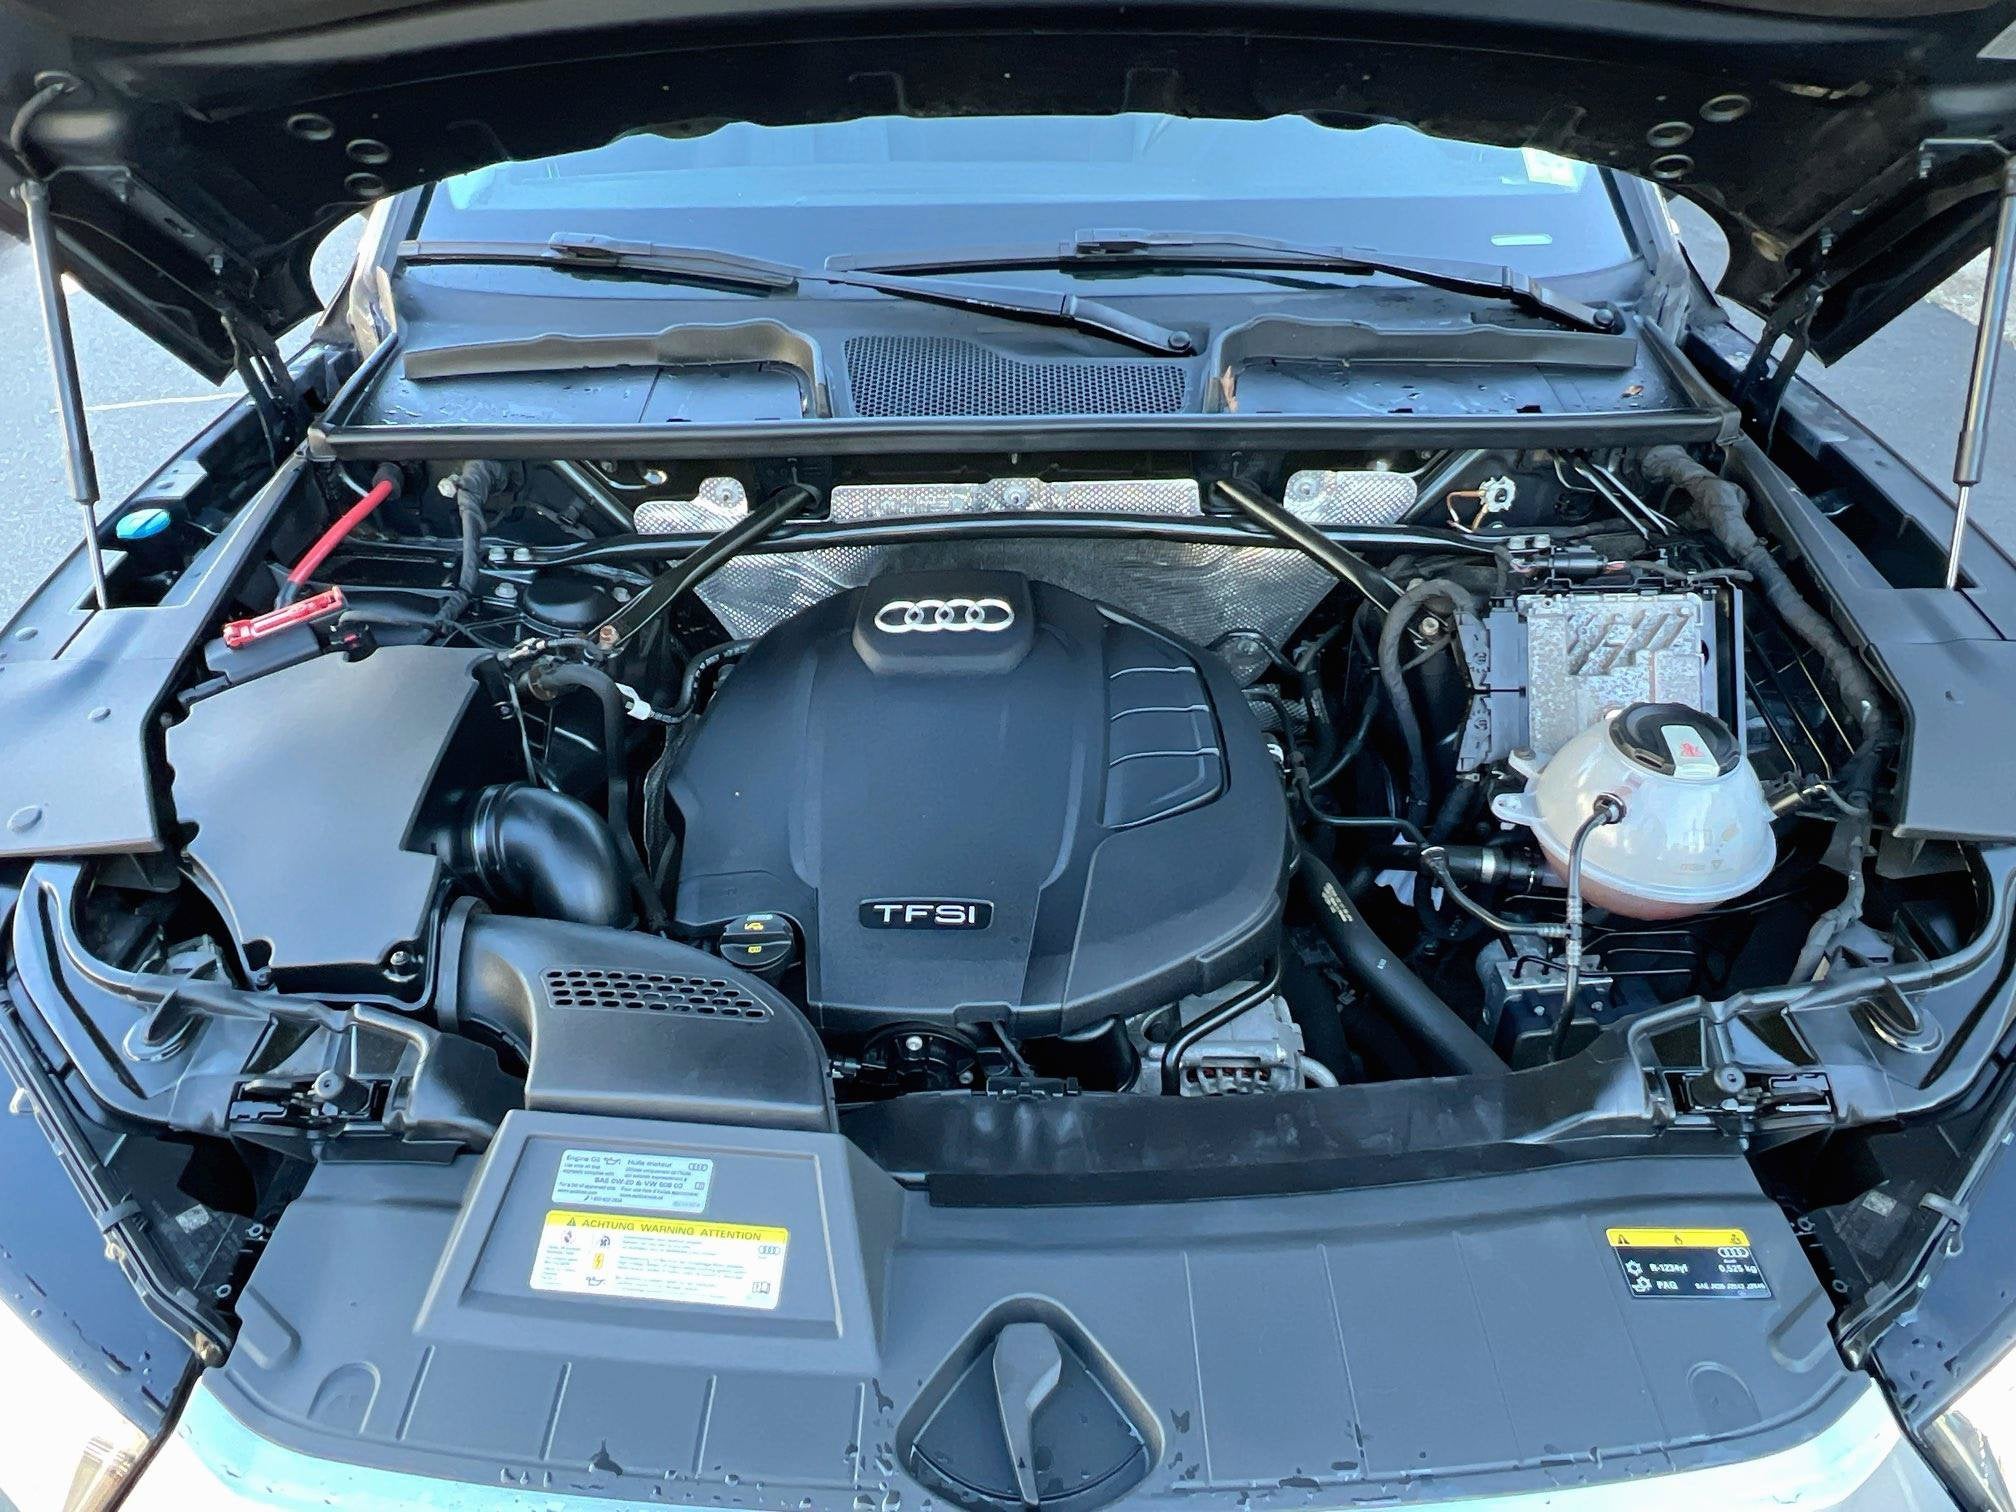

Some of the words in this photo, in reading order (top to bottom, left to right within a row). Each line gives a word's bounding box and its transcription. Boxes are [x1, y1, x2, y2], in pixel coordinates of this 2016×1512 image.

[873, 904, 976, 925] TFSI
[582, 1219, 635, 1231] ACHTUNG
[639, 1224, 695, 1236] WARNING
[700, 1228, 762, 1241] ATTENTION
[1744, 1264, 1758, 1274] kg
